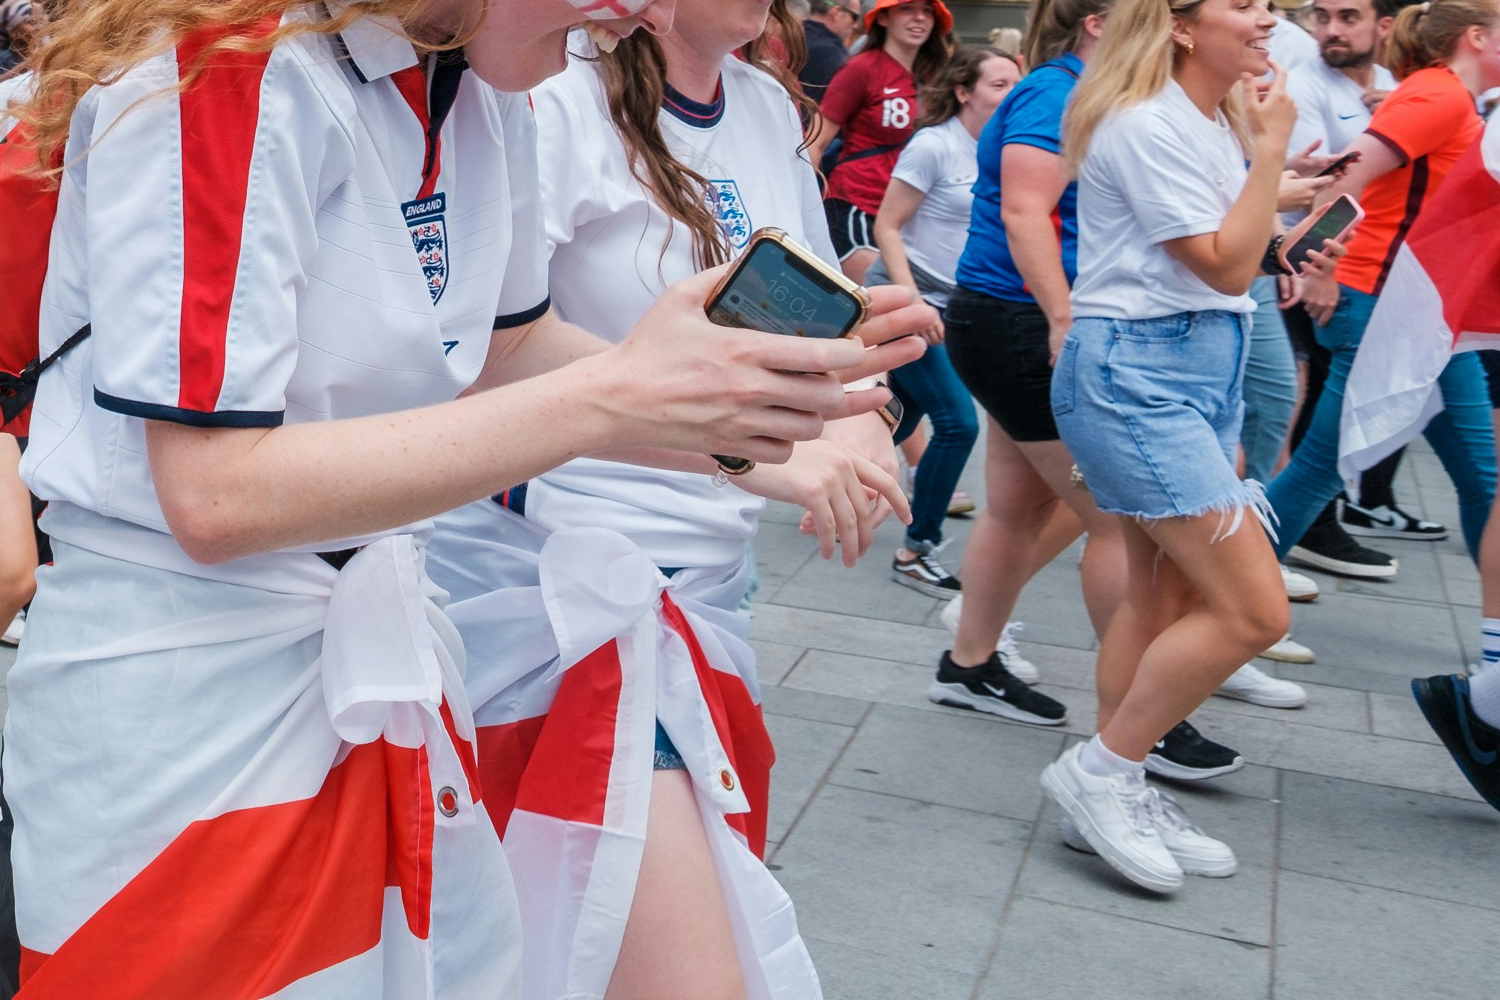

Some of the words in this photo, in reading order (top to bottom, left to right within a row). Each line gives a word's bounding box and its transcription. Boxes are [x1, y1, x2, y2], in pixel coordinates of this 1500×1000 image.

[882, 97, 910, 129] 18
[405, 198, 442, 217] ENGLAND
[766, 279, 817, 323] 16:04
